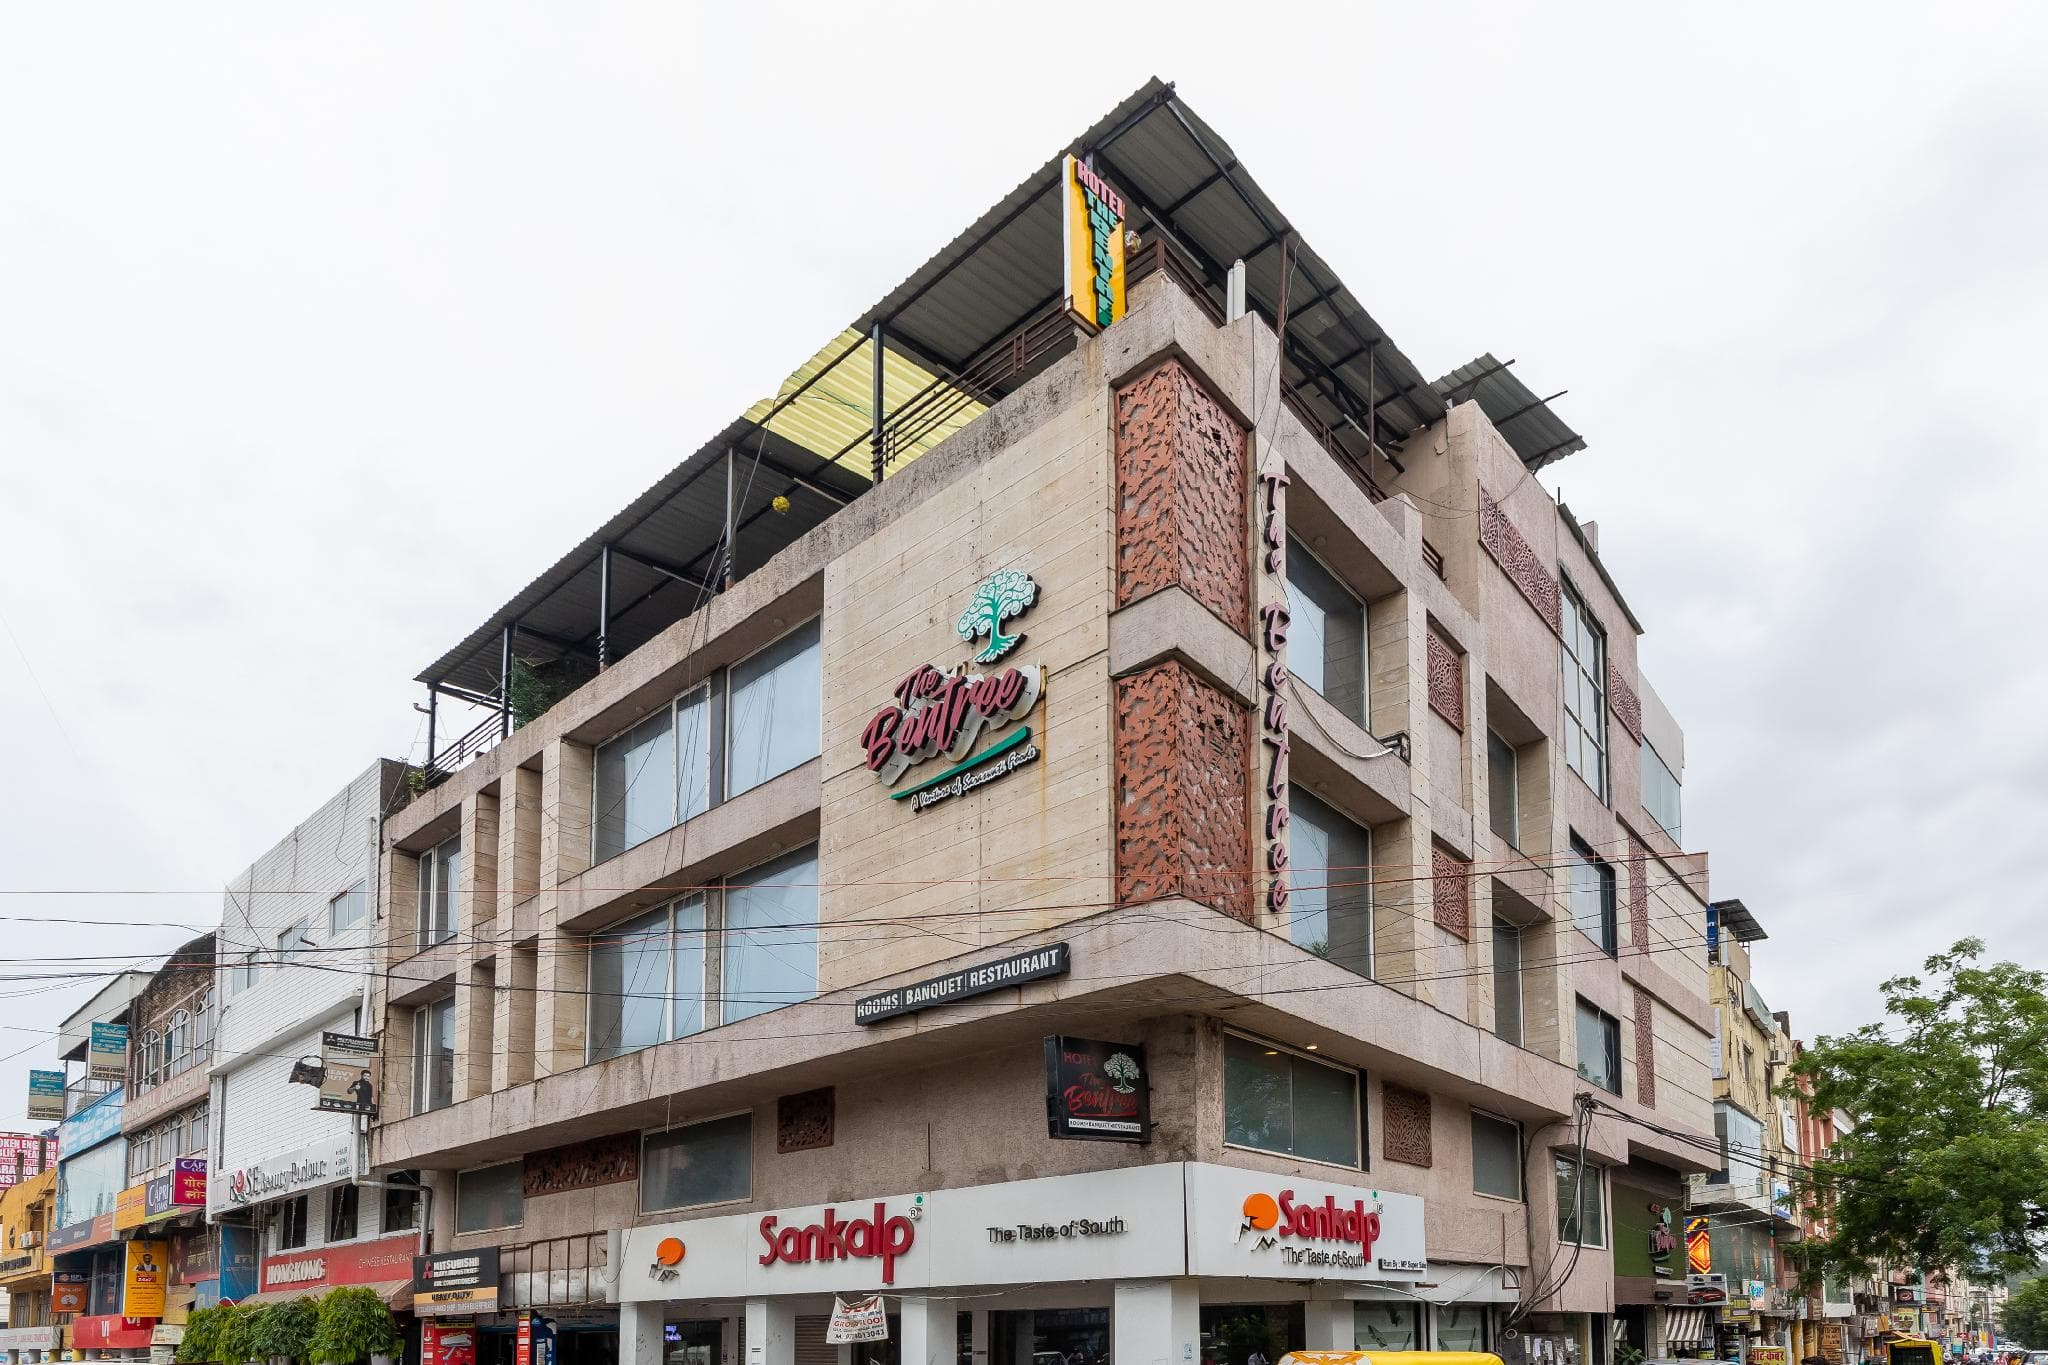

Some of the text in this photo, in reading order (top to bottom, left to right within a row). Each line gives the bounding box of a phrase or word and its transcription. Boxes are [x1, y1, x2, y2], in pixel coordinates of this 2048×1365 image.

[1075, 158, 1124, 221] HOTEL
[1084, 187, 1118, 232] THE
[894, 663, 944, 709] The
[911, 793, 920, 813] A
[951, 776, 963, 796] of
[1008, 744, 1037, 770] Foods
[857, 949, 1059, 1018] ROOMS BANQUET RESTAURANT
[148, 1181, 169, 1207] CAPRI
[759, 1202, 914, 1285] Sankalp
[986, 1215, 1125, 1243] The Taste of South
[1279, 1189, 1381, 1263] Sankalp
[267, 1258, 326, 1285] HONGKONG
[433, 1256, 480, 1271] MITSUBISHI
[1284, 1245, 1366, 1267] The Taste of South
